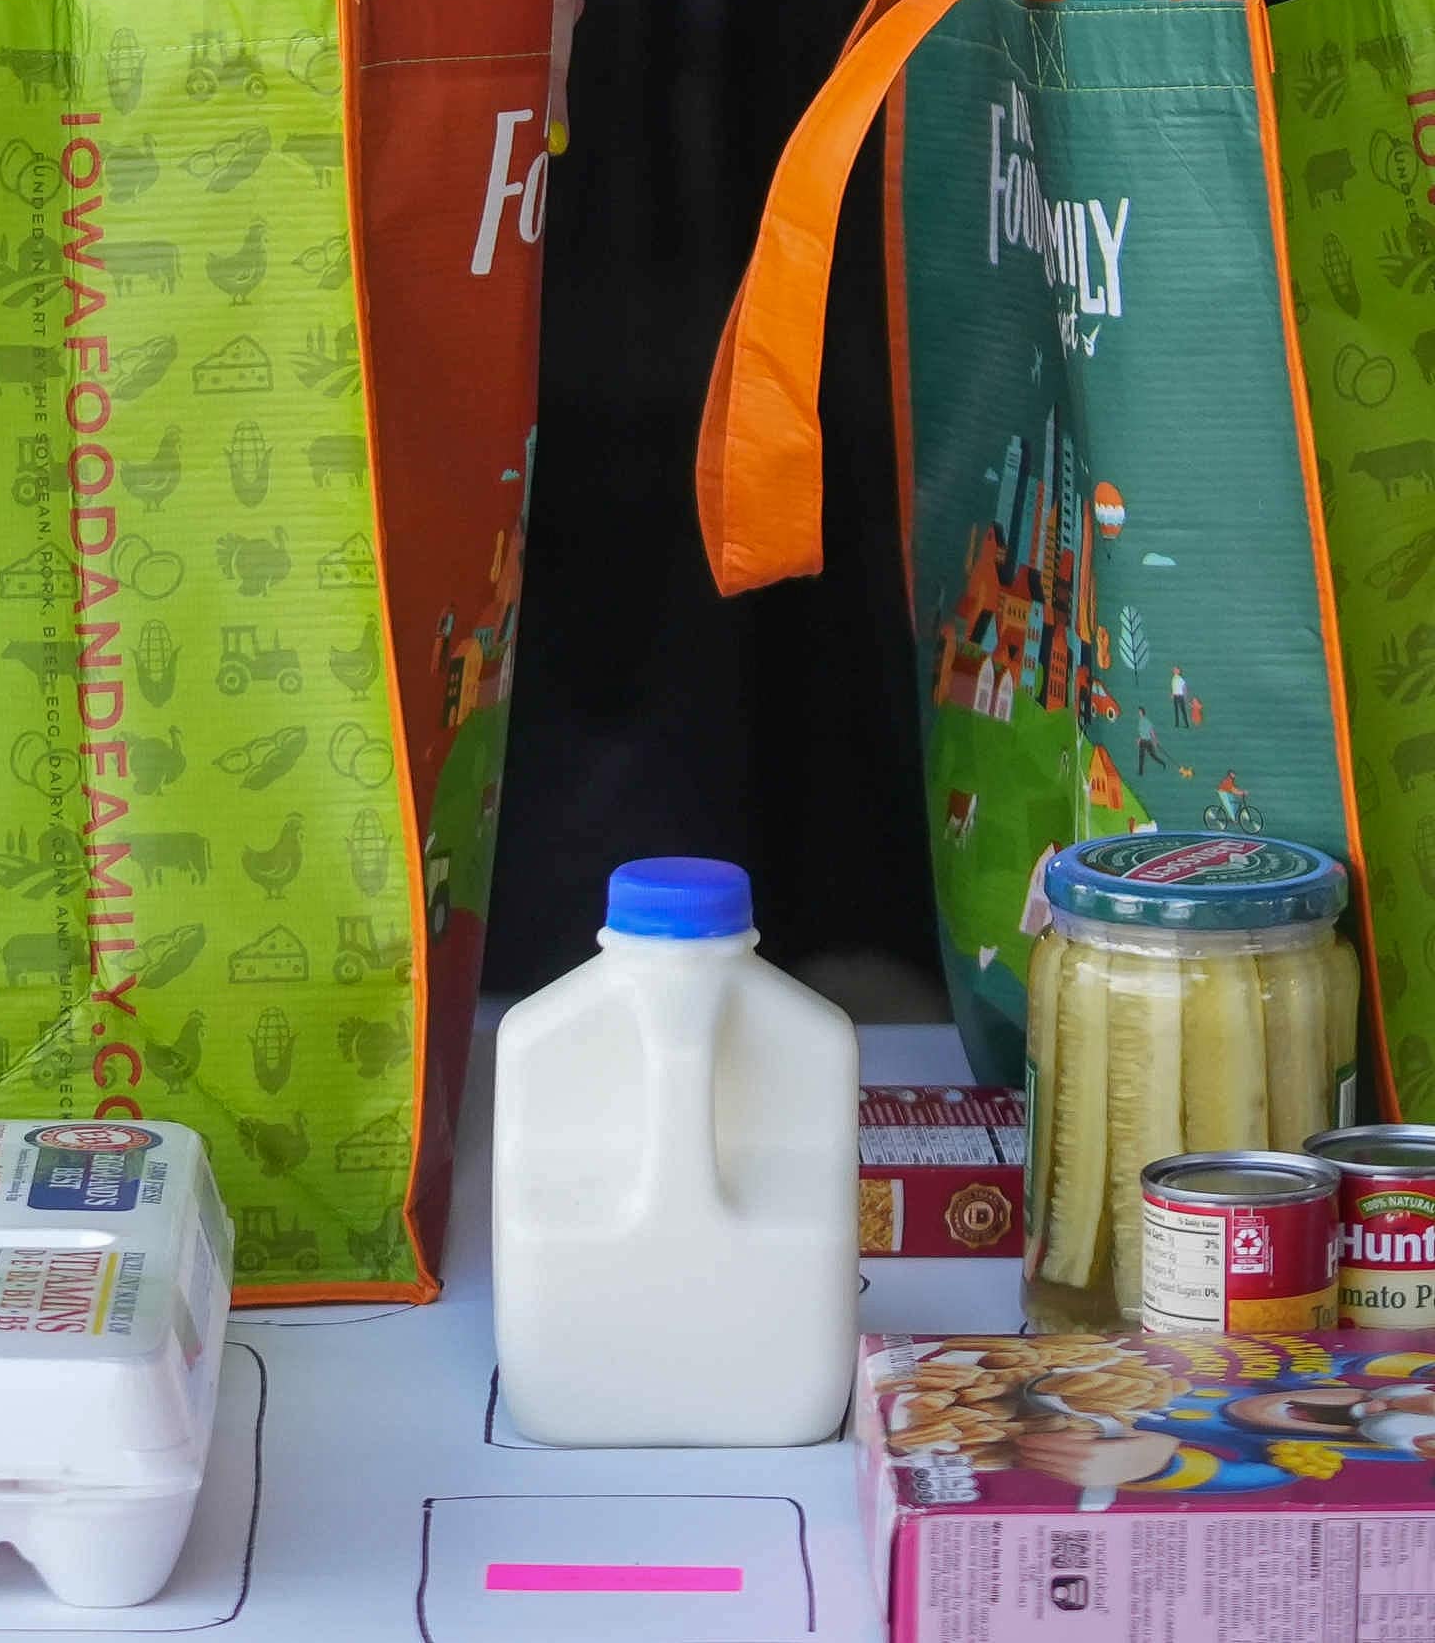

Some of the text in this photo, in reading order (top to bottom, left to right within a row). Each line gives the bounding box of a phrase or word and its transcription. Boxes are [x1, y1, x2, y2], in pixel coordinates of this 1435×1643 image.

[31, 152, 47, 238] FUNDED
[32, 284, 47, 336] PART
[34, 384, 49, 422] THE
[53, 838, 69, 895] CORN
[58, 905, 71, 951] AND
[59, 1052, 75, 1120] CHEC
[49, 1167, 84, 1189] BEST
[84, 1154, 125, 1206] EGGLAND'S
[35, 1251, 103, 1333] VITAMINS
[1204, 1287, 1219, 1299] 0%
